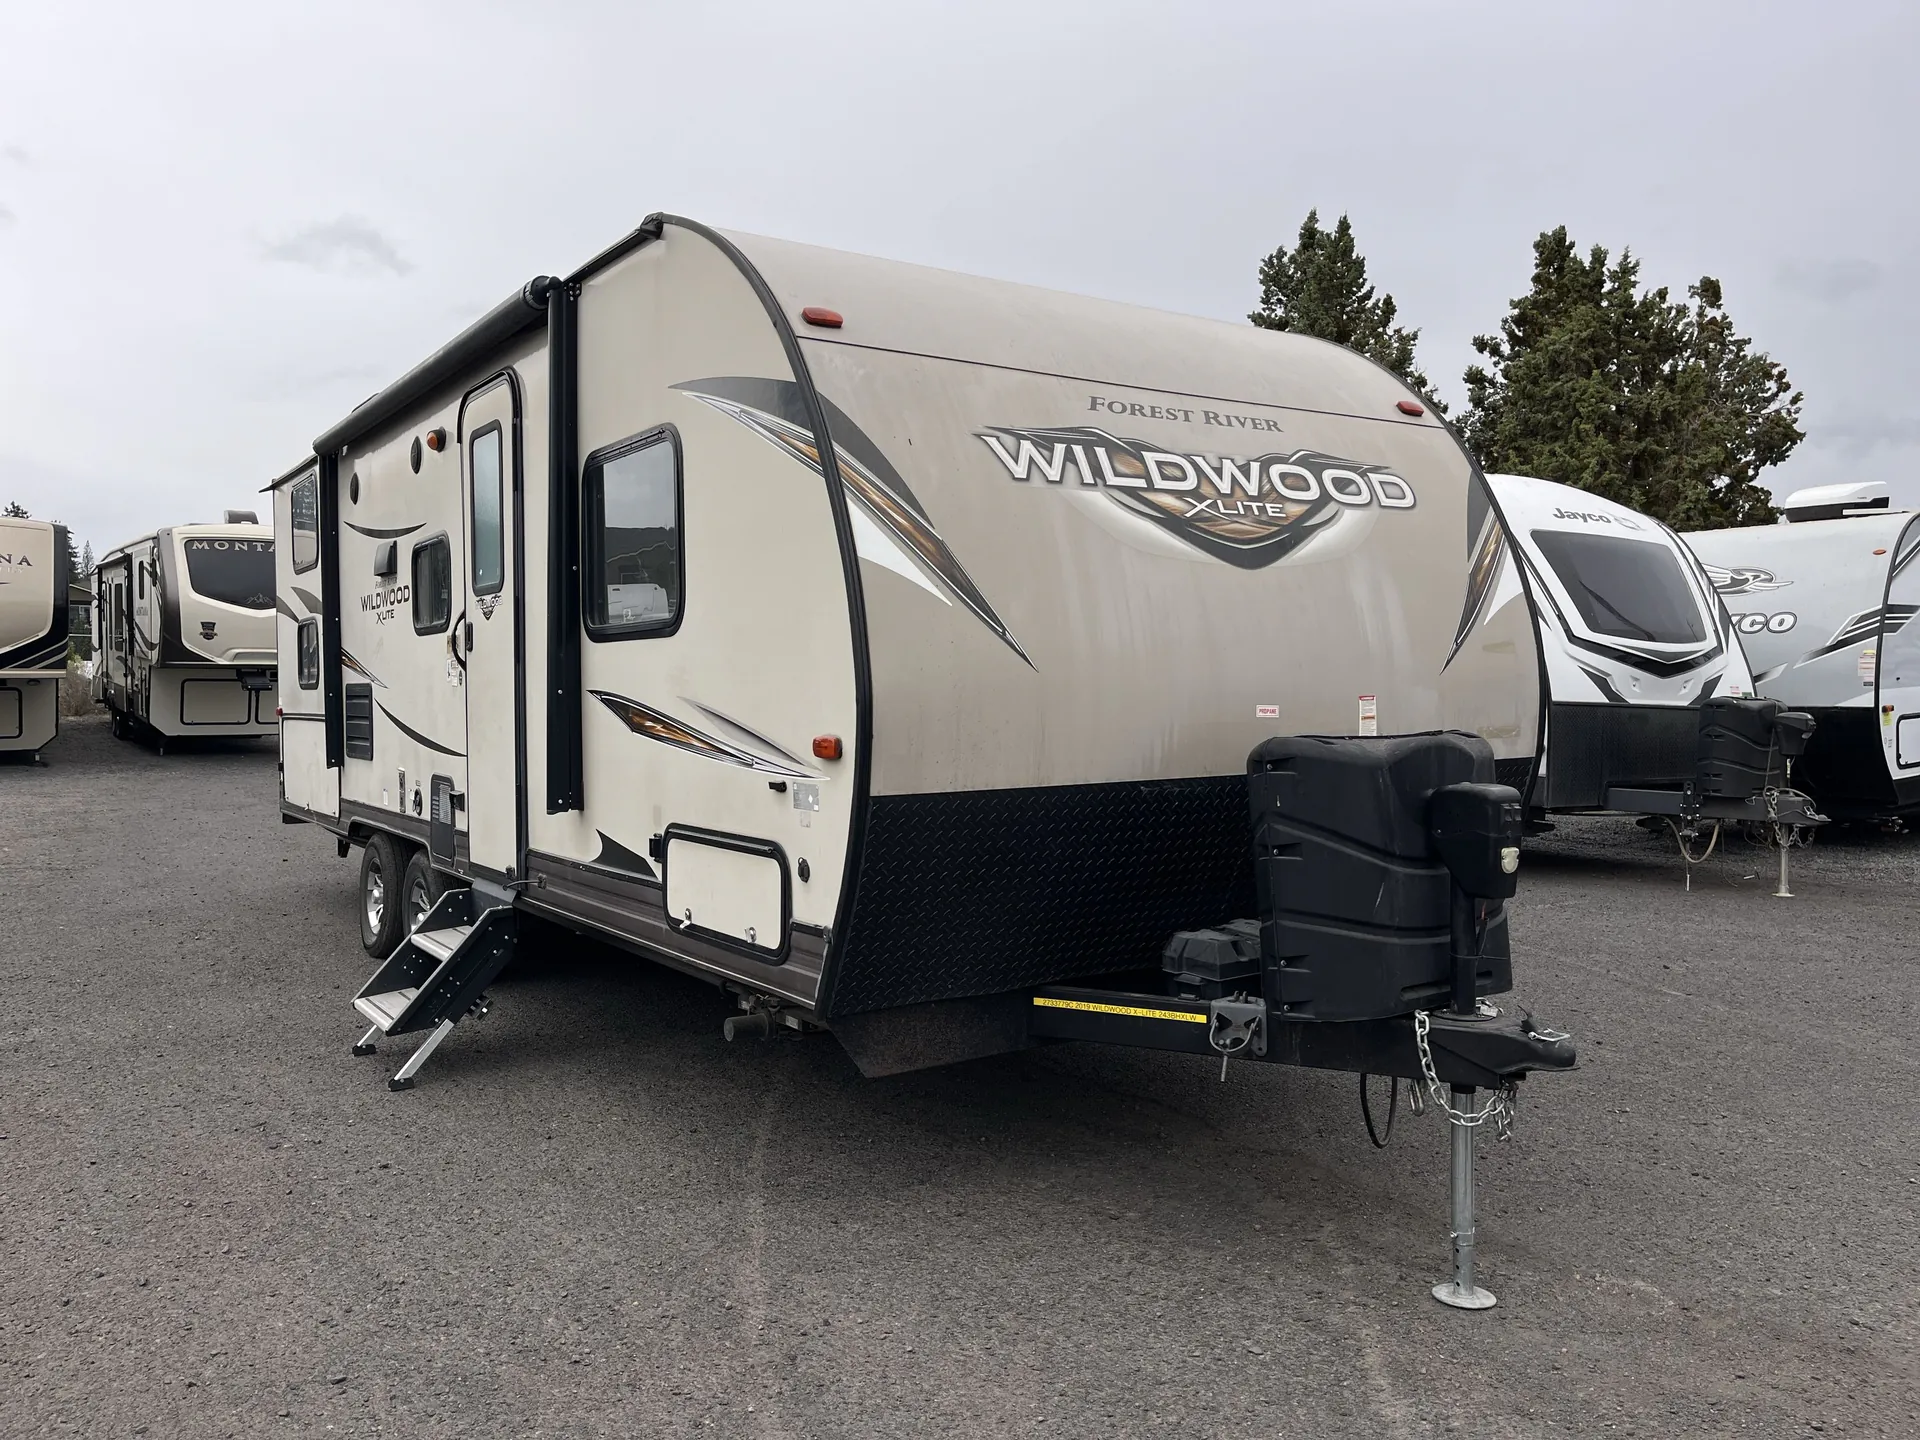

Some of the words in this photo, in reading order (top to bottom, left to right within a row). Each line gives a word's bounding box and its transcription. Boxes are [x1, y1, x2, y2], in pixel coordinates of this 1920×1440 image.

[1087, 395, 1195, 423] FOREST
[1201, 409, 1285, 433] RIVER
[978, 433, 1418, 510] WILDWOOD
[1183, 497, 1287, 520] XLITE
[1552, 507, 1612, 523] Jayco
[360, 584, 411, 612] WILDWOOD
[1075, 1001, 1091, 1010] 2019
[1091, 1003, 1132, 1015] WILDWOOD
[1133, 1008, 1157, 1017] X-LITE
